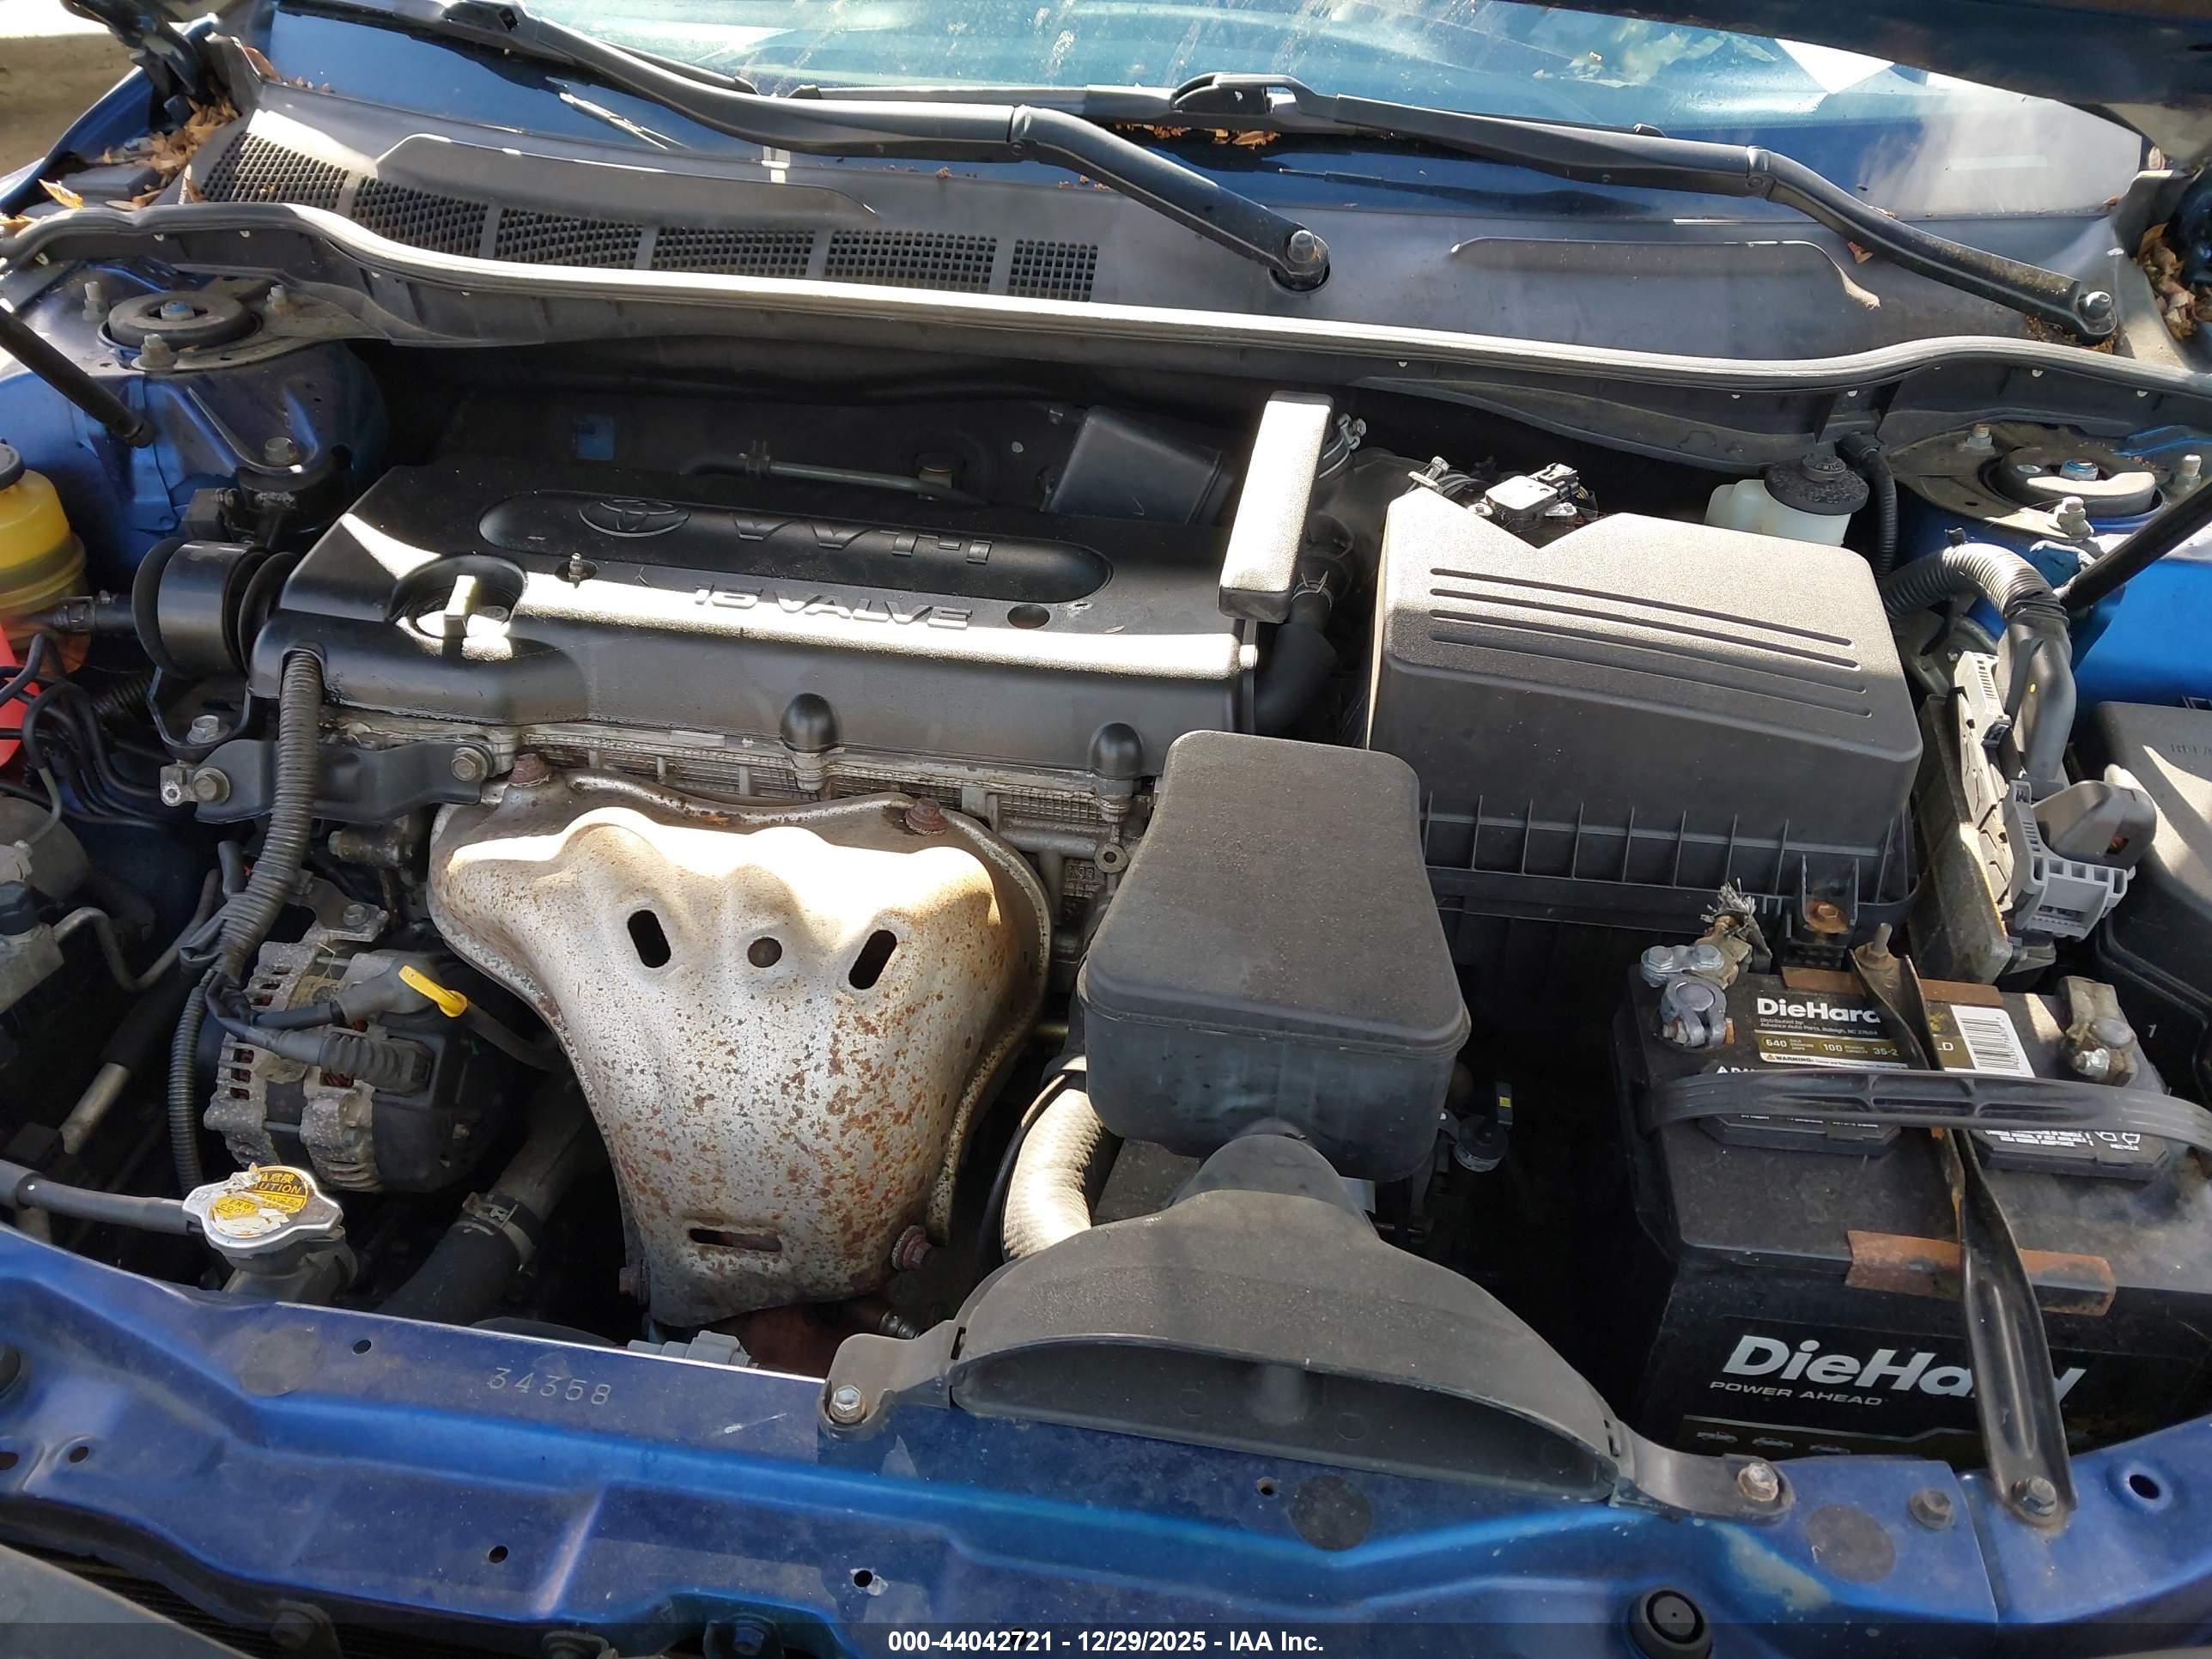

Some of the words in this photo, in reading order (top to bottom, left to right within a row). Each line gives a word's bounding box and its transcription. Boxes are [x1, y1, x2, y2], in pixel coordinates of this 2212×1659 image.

[775, 591, 972, 630] VALVE
[1765, 1038, 1787, 1048] 640
[1822, 1043, 1843, 1052] 100
[253, 1182, 301, 1194] UTION
[487, 1367, 611, 1405] 34358
[1710, 1381, 1792, 1398] POWER
[1800, 1390, 1883, 1406] AHEAD
